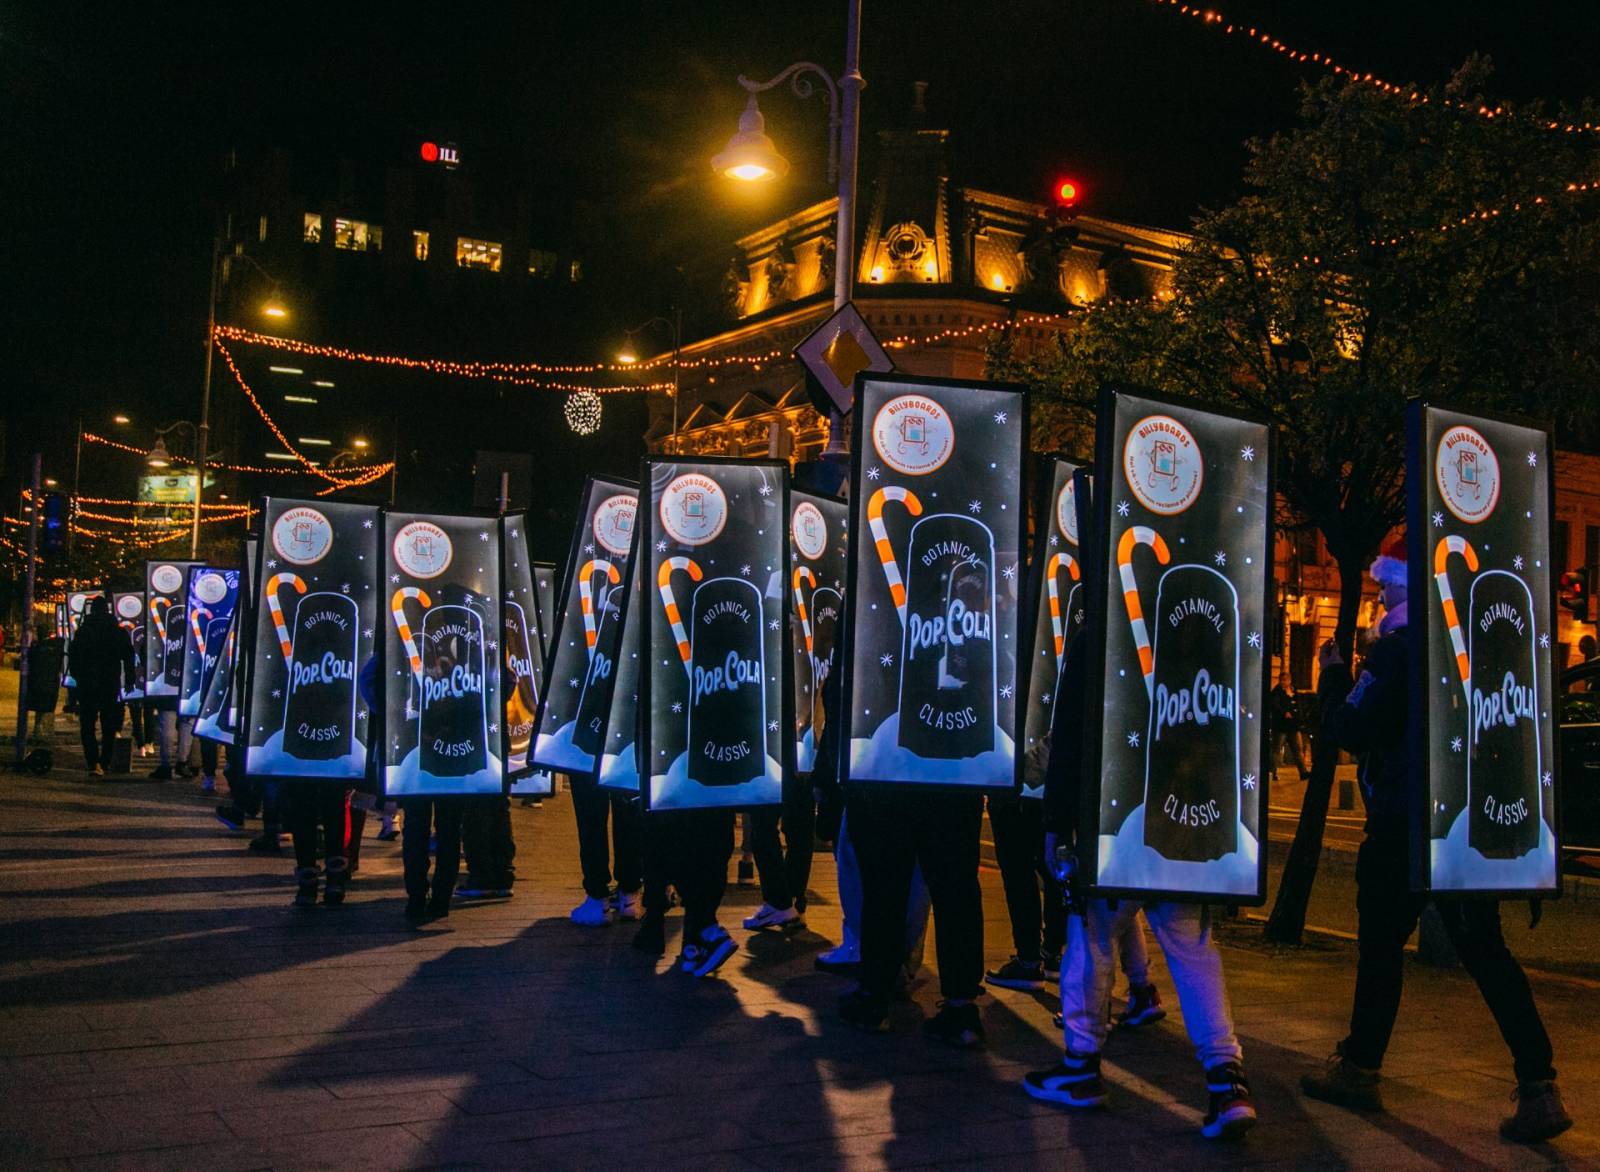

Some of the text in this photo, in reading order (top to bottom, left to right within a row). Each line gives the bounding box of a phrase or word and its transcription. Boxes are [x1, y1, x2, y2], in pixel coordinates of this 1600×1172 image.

[888, 401, 941, 420] BILLYBOARDS
[1138, 421, 1190, 448] BILLYBOARDS
[1445, 432, 1488, 456] BILLYBOARDS
[672, 479, 717, 494] BILLYBOARDS
[922, 540, 984, 569] BOTANICAL
[304, 610, 349, 632] BOTANICAL
[703, 600, 751, 625] BOTANICAL
[1169, 598, 1225, 633] BOTANICAL
[1480, 602, 1525, 636] BOTANICAL
[432, 624, 474, 643] BOTANICAL
[919, 703, 977, 730] CLASSIC
[298, 722, 340, 741] CLASSIC
[433, 738, 475, 757] CLASSIC
[704, 740, 750, 762] CLASSIC
[1164, 793, 1220, 827] CLASSIC
[1484, 794, 1528, 826] CLASSIC
